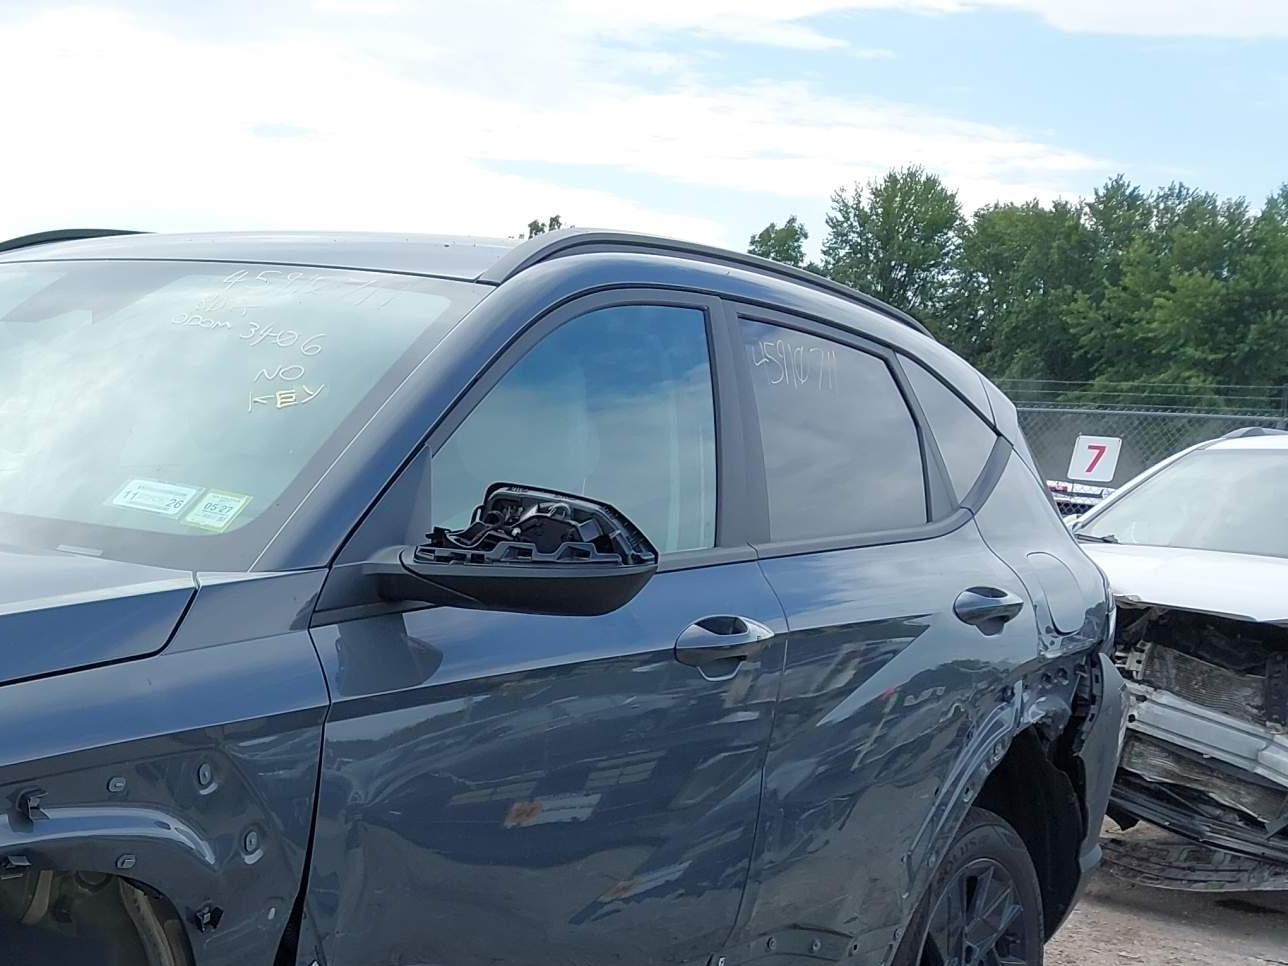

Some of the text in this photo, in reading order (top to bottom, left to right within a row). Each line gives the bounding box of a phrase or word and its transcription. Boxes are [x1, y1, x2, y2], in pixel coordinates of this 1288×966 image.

[239, 321, 328, 356] 3406
[253, 364, 305, 383] NO
[248, 384, 327, 413] KEY
[1084, 444, 1107, 473] 7
